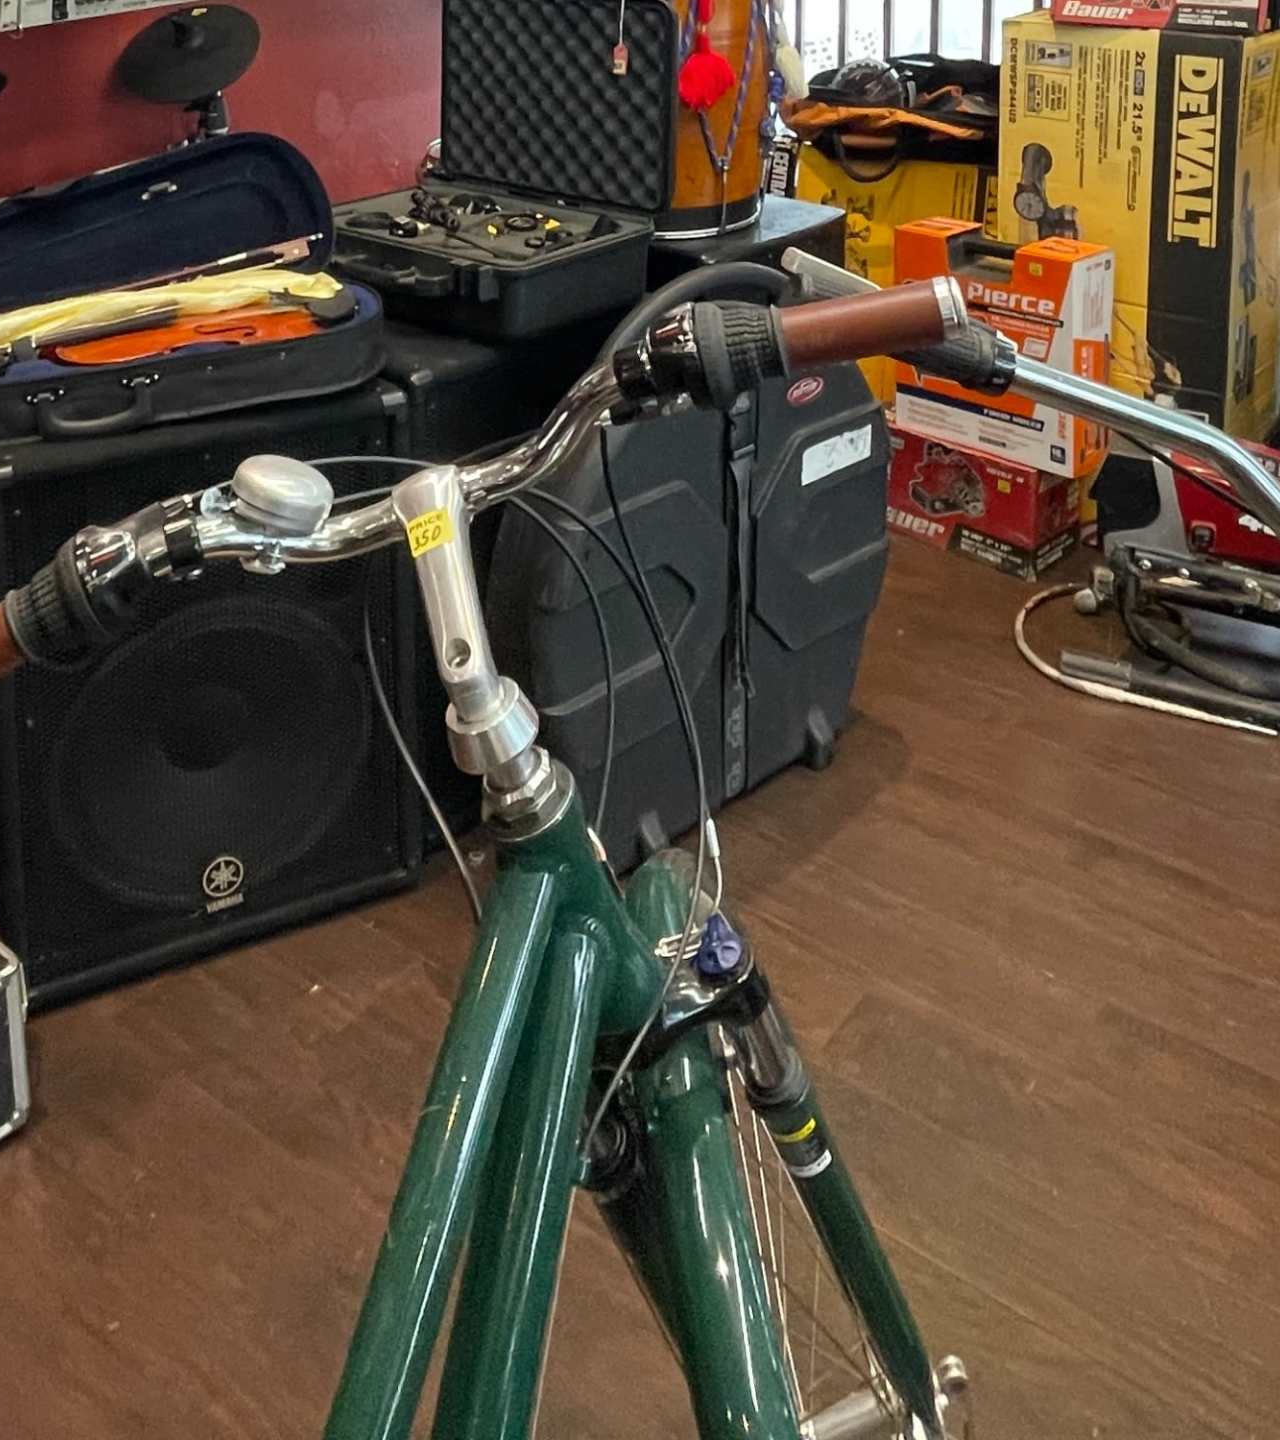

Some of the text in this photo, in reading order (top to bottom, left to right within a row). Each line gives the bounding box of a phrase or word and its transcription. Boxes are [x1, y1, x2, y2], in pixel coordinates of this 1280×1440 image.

[1062, 0, 1134, 20] Bauer
[1169, 54, 1222, 248] DEWALT
[967, 282, 1056, 316] Pierce
